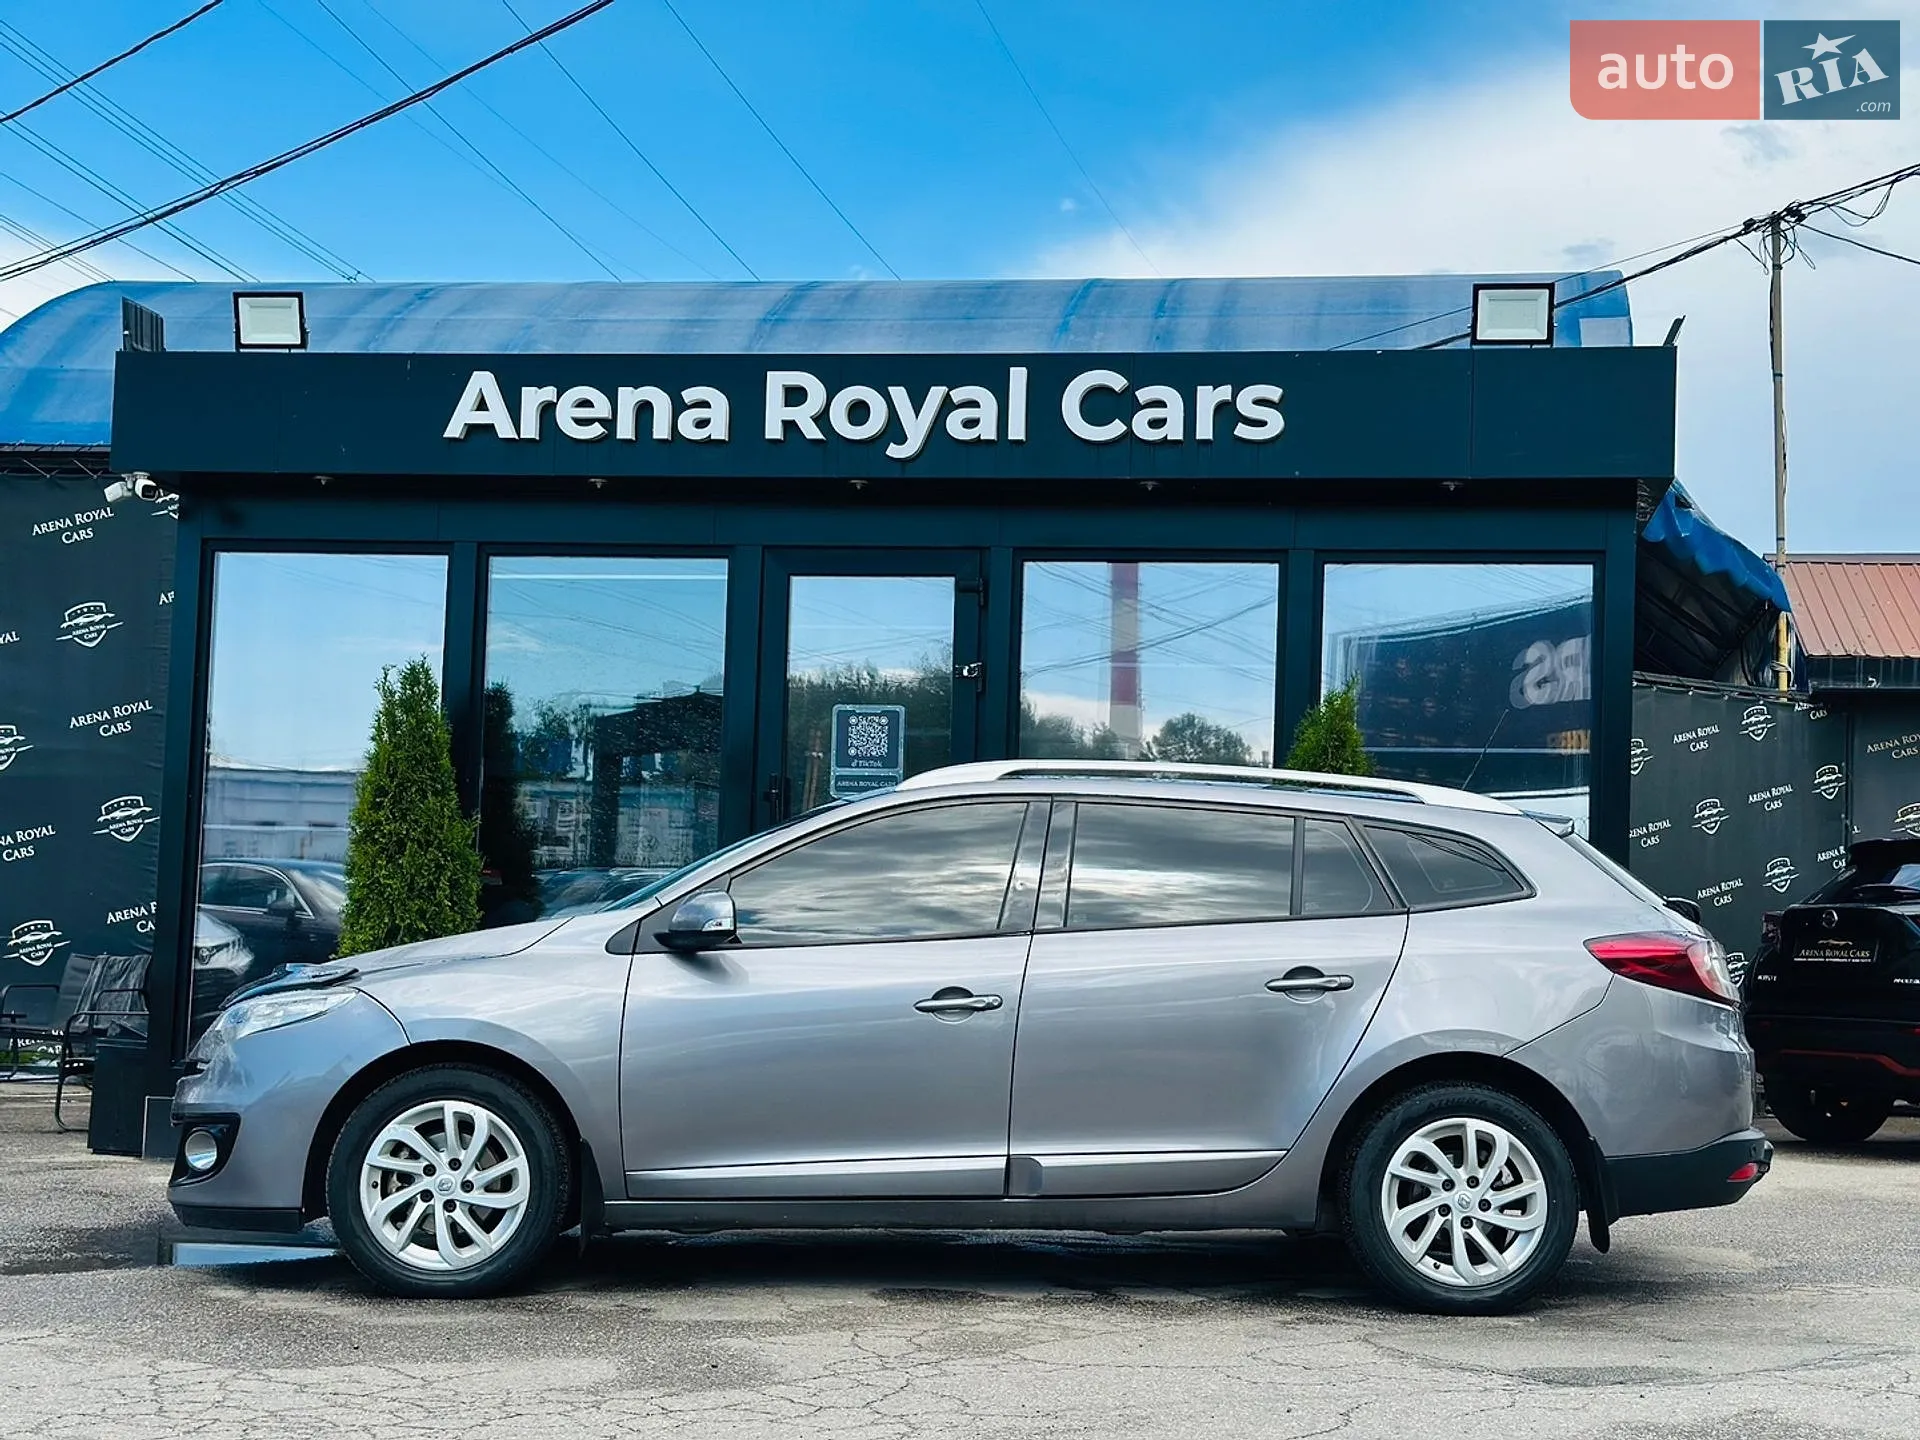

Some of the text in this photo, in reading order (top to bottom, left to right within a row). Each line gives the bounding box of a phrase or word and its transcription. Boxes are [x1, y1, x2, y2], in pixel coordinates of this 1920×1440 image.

[443, 366, 1285, 460] Arena Royal Cars
[32, 506, 115, 536] ARENA ROYAL
[61, 527, 94, 544] CARS
[69, 699, 153, 729] ARENA ROYAL
[99, 720, 132, 738] CARS
[1672, 724, 1720, 744] ARENA ROYAL
[1689, 740, 1709, 752] CARS
[1866, 738, 1900, 753] ARENA
[1891, 746, 1919, 759] CARS
[1747, 783, 1794, 804] ARENA ROYAL
[1763, 799, 1783, 812] CARS
[15, 823, 57, 843] ROYAL
[1648, 819, 1672, 833] ROYAL
[1640, 835, 1660, 848] CARS
[2, 845, 35, 862] CARS
[1696, 878, 1744, 900] ARENA ROYAL
[1713, 893, 1733, 907] CARS
[106, 904, 149, 924] ARENA
